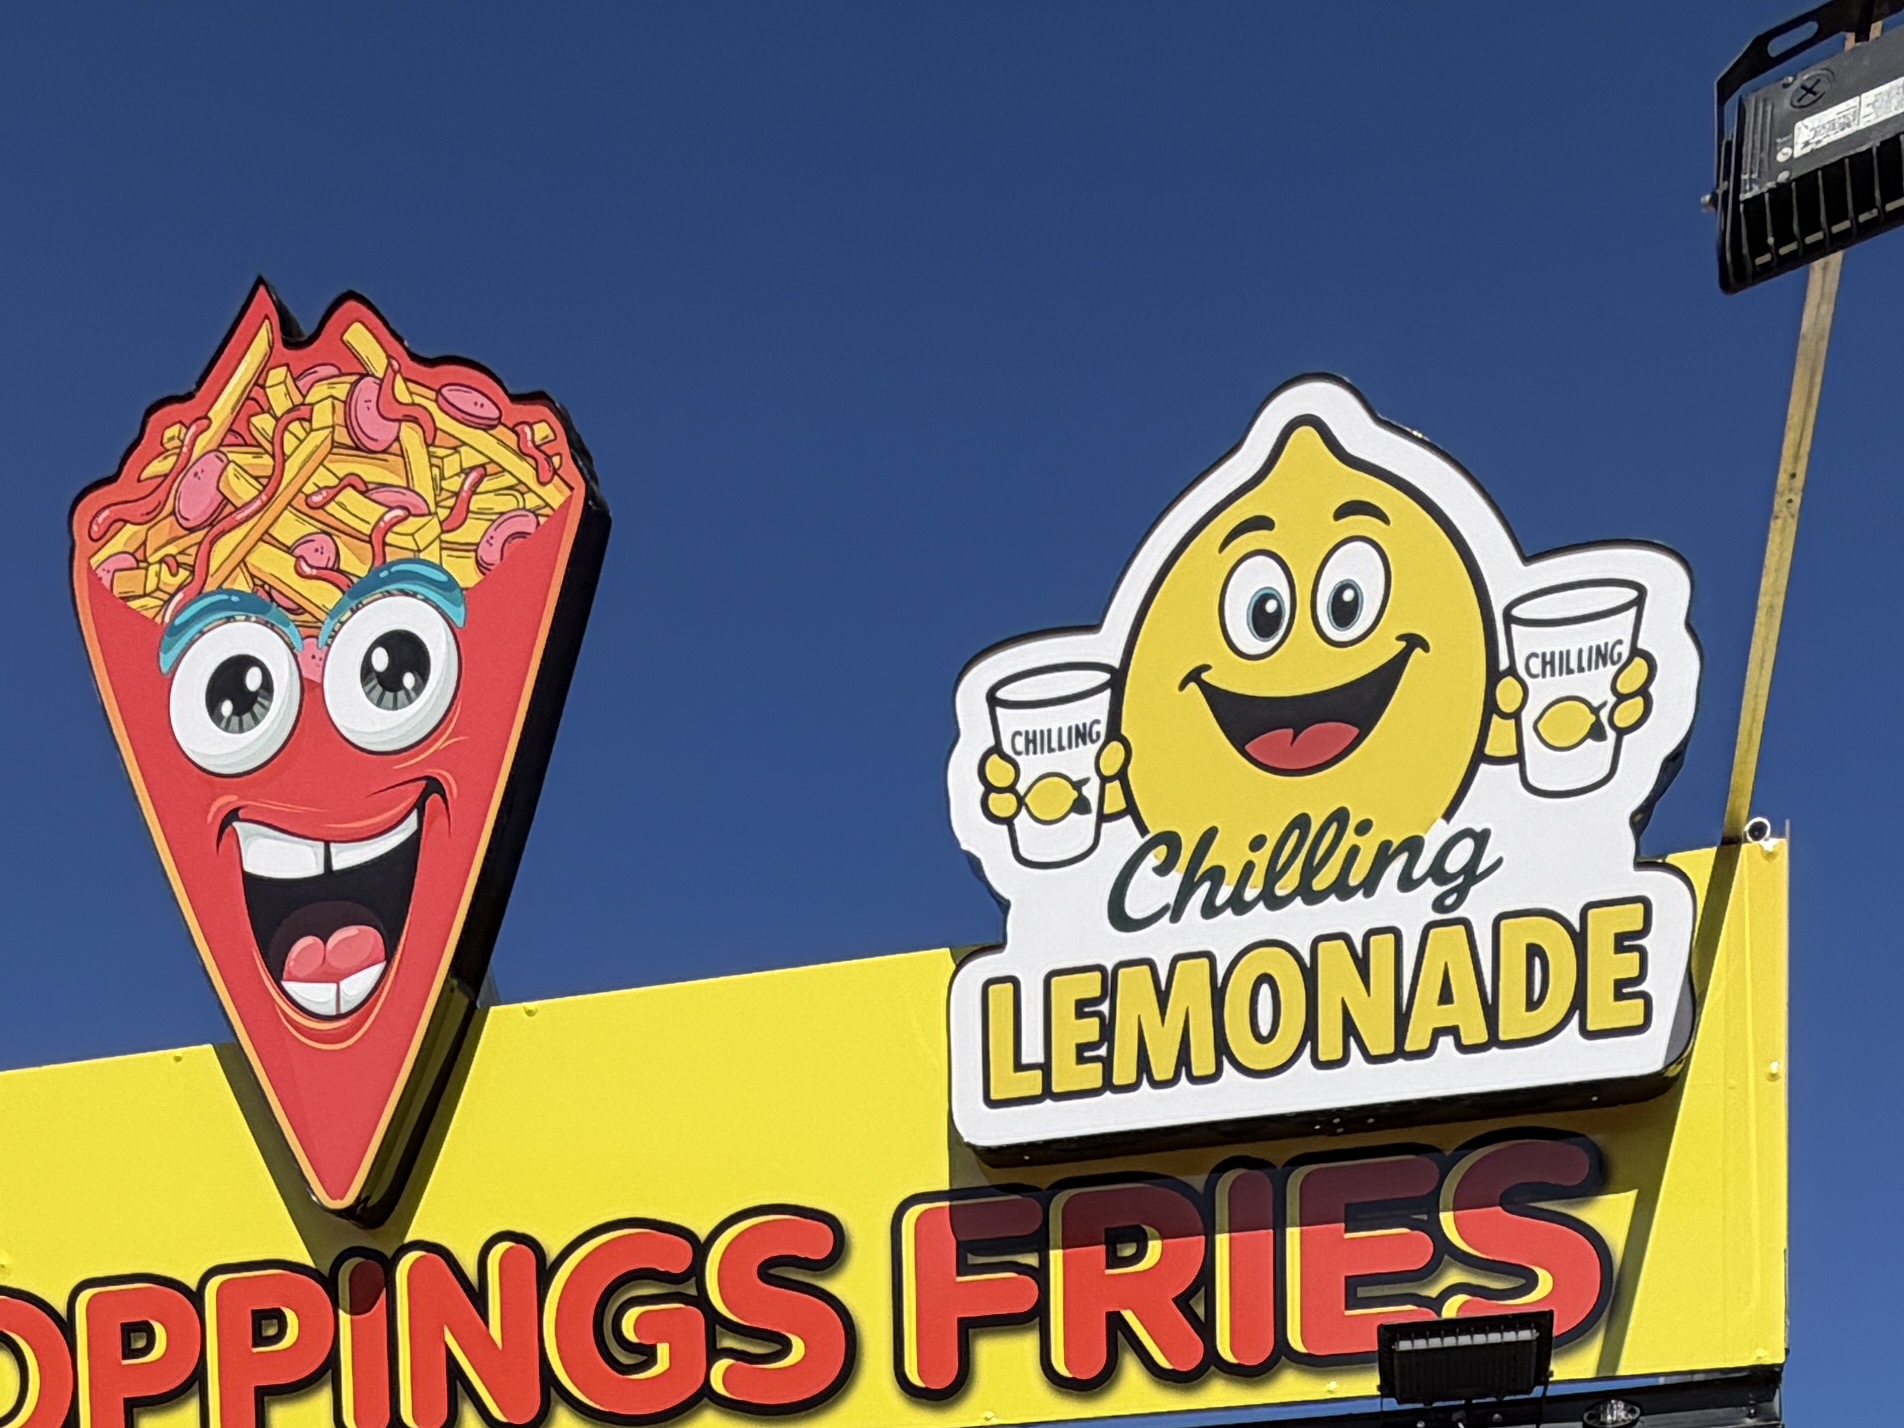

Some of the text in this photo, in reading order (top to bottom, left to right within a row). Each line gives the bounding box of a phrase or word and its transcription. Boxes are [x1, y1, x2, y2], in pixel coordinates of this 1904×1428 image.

[1524, 640, 1623, 681] CHILLING
[1011, 720, 1101, 758] CHILLING
[1108, 806, 1502, 933] Chilling
[982, 897, 1652, 1109] LEMONADE
[893, 1127, 1613, 1399] FRIES
